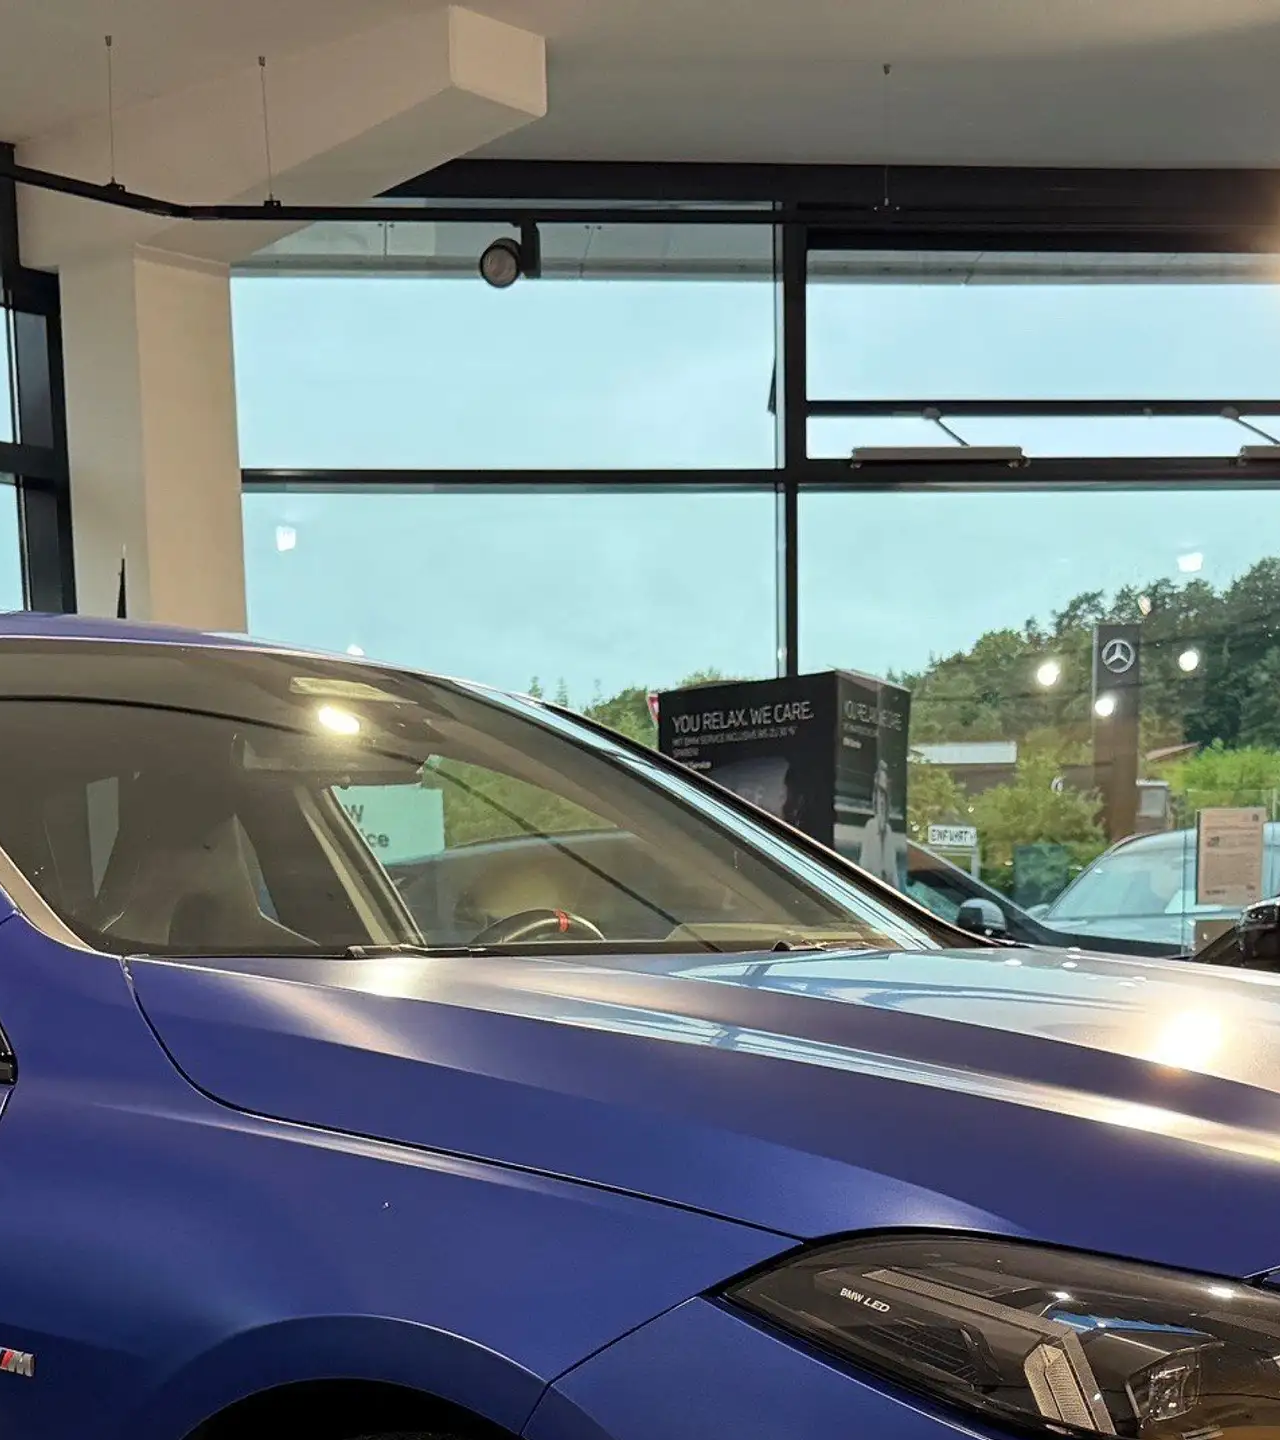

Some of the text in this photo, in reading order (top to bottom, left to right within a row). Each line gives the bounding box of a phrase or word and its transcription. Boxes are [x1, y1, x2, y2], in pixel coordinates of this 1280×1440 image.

[672, 701, 815, 733] YOU RELAX. WE CARE.
[840, 1287, 891, 1313] BMW LED
